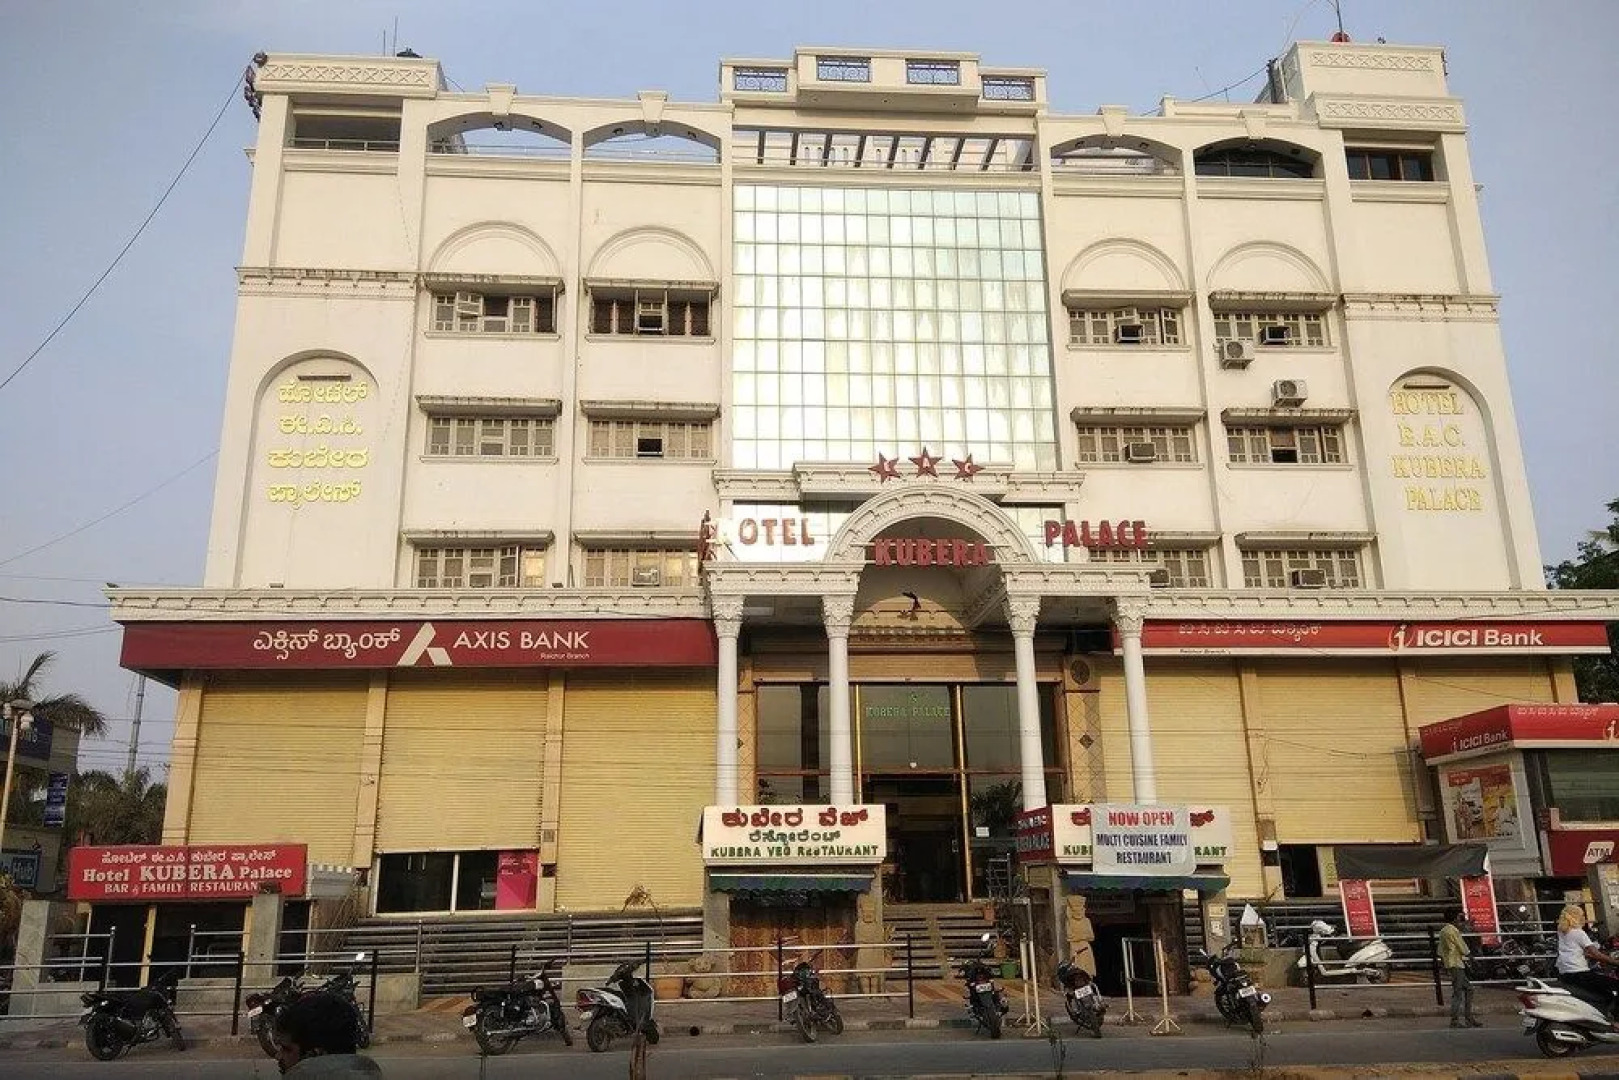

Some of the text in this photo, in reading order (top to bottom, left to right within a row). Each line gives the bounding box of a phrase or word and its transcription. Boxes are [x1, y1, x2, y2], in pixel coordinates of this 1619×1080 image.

[1391, 392, 1464, 415] HOTEL
[1391, 455, 1487, 479] KUBERA
[1404, 486, 1483, 511] PALACE
[875, 538, 989, 567] KUBERA
[1044, 520, 1147, 548] PALACE
[253, 628, 401, 660] ಎಕ್ಸಿಸ್ ಬ್ಯಾಂಕ್
[454, 631, 590, 649] AXIS BANK
[1417, 629, 1478, 647] ICICI
[1484, 629, 1544, 646] Bank
[1459, 734, 1482, 750] ICICI
[1484, 730, 1510, 745] Bank
[721, 807, 803, 827] ಕುಬೇರ
[1108, 812, 1174, 826] NOW OPEN
[1096, 834, 1187, 847] MULTI CUISINE FAMILY
[711, 847, 762, 857] KUBERA
[767, 846, 791, 857] VEG
[1117, 852, 1172, 863] RESTAURANT
[83, 864, 293, 882] Hotel KUBERA Palace
[105, 884, 129, 893] BAR
[142, 883, 183, 893] FAMILY
